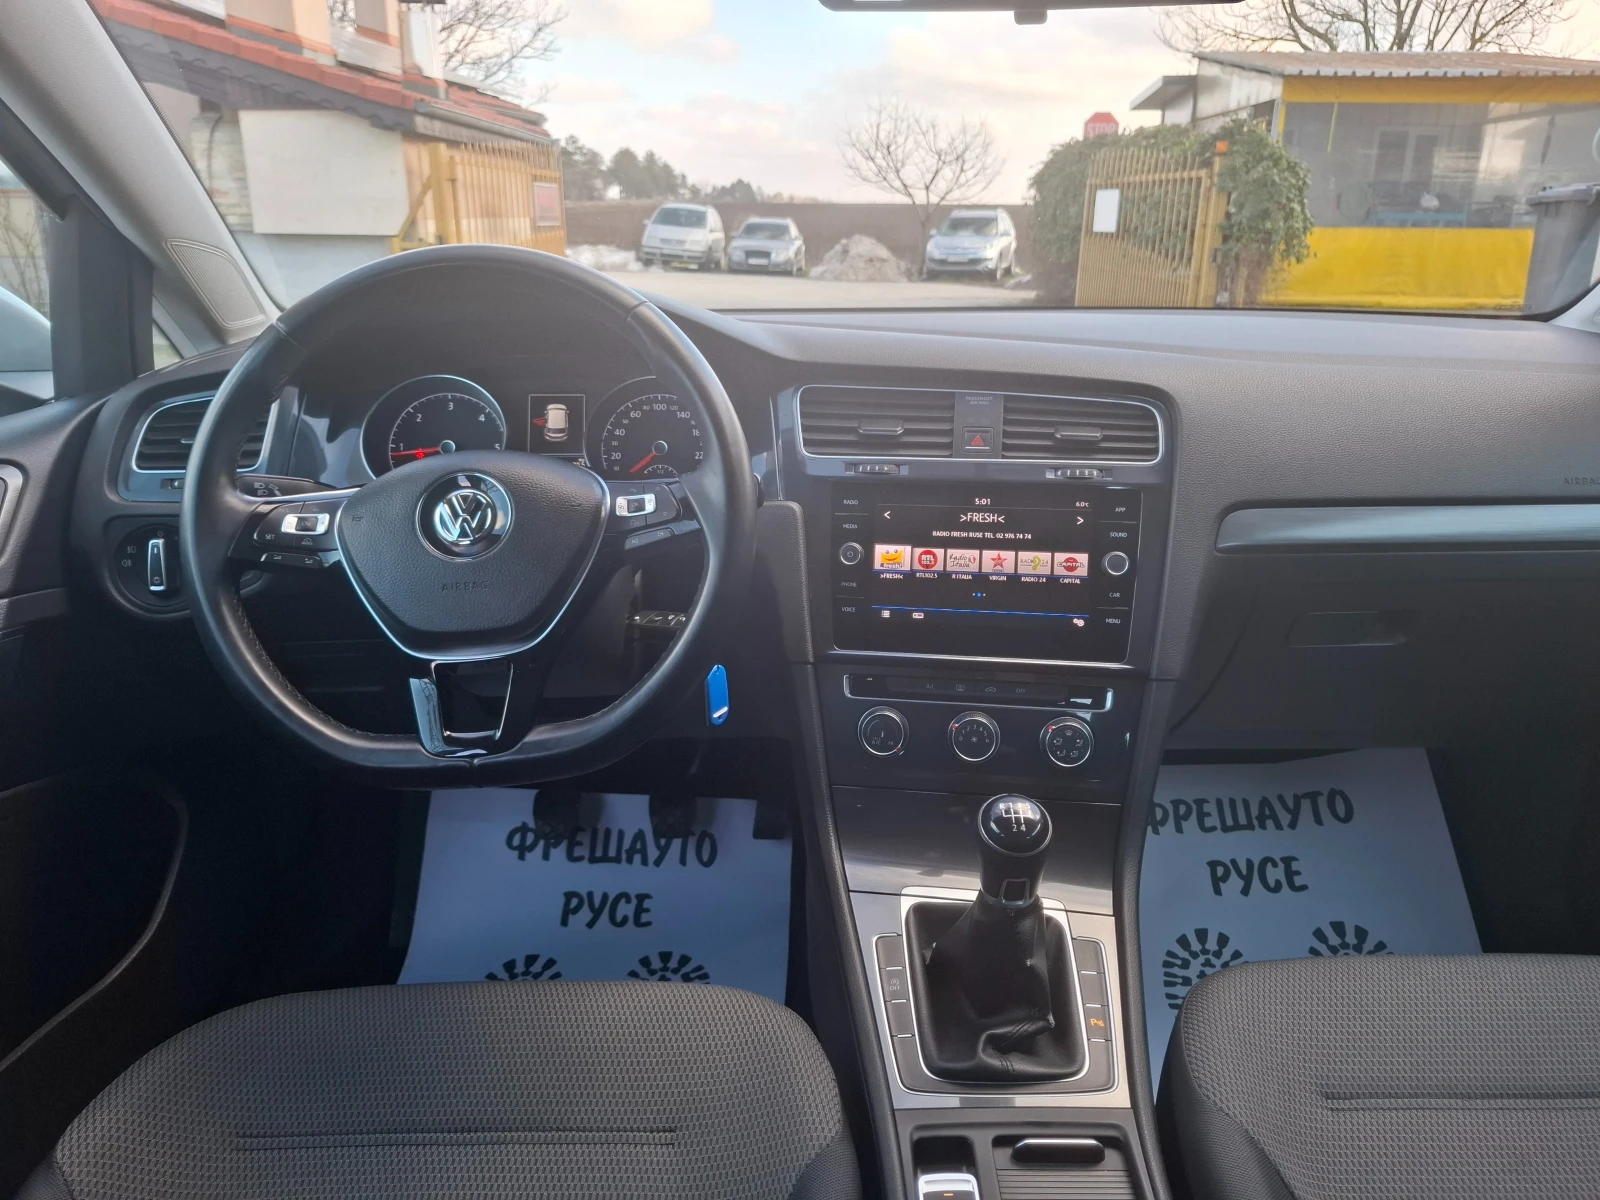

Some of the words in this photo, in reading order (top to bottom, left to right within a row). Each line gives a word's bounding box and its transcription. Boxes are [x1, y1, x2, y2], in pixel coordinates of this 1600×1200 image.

[448, 402, 454, 410] 3
[652, 403, 667, 411] 100
[416, 414, 422, 422] 2
[478, 414, 485, 422] 4
[676, 411, 691, 419] 140
[614, 428, 626, 436] 40
[611, 452, 621, 460] 20
[949, 553, 968, 562] Radio
[1060, 577, 1081, 585] CAPITAL
[441, 581, 488, 592] AIRBAG
[1012, 824, 1018, 832] 2
[1206, 855, 1309, 897] РУСЕ
[560, 890, 654, 930] РУСЕ
